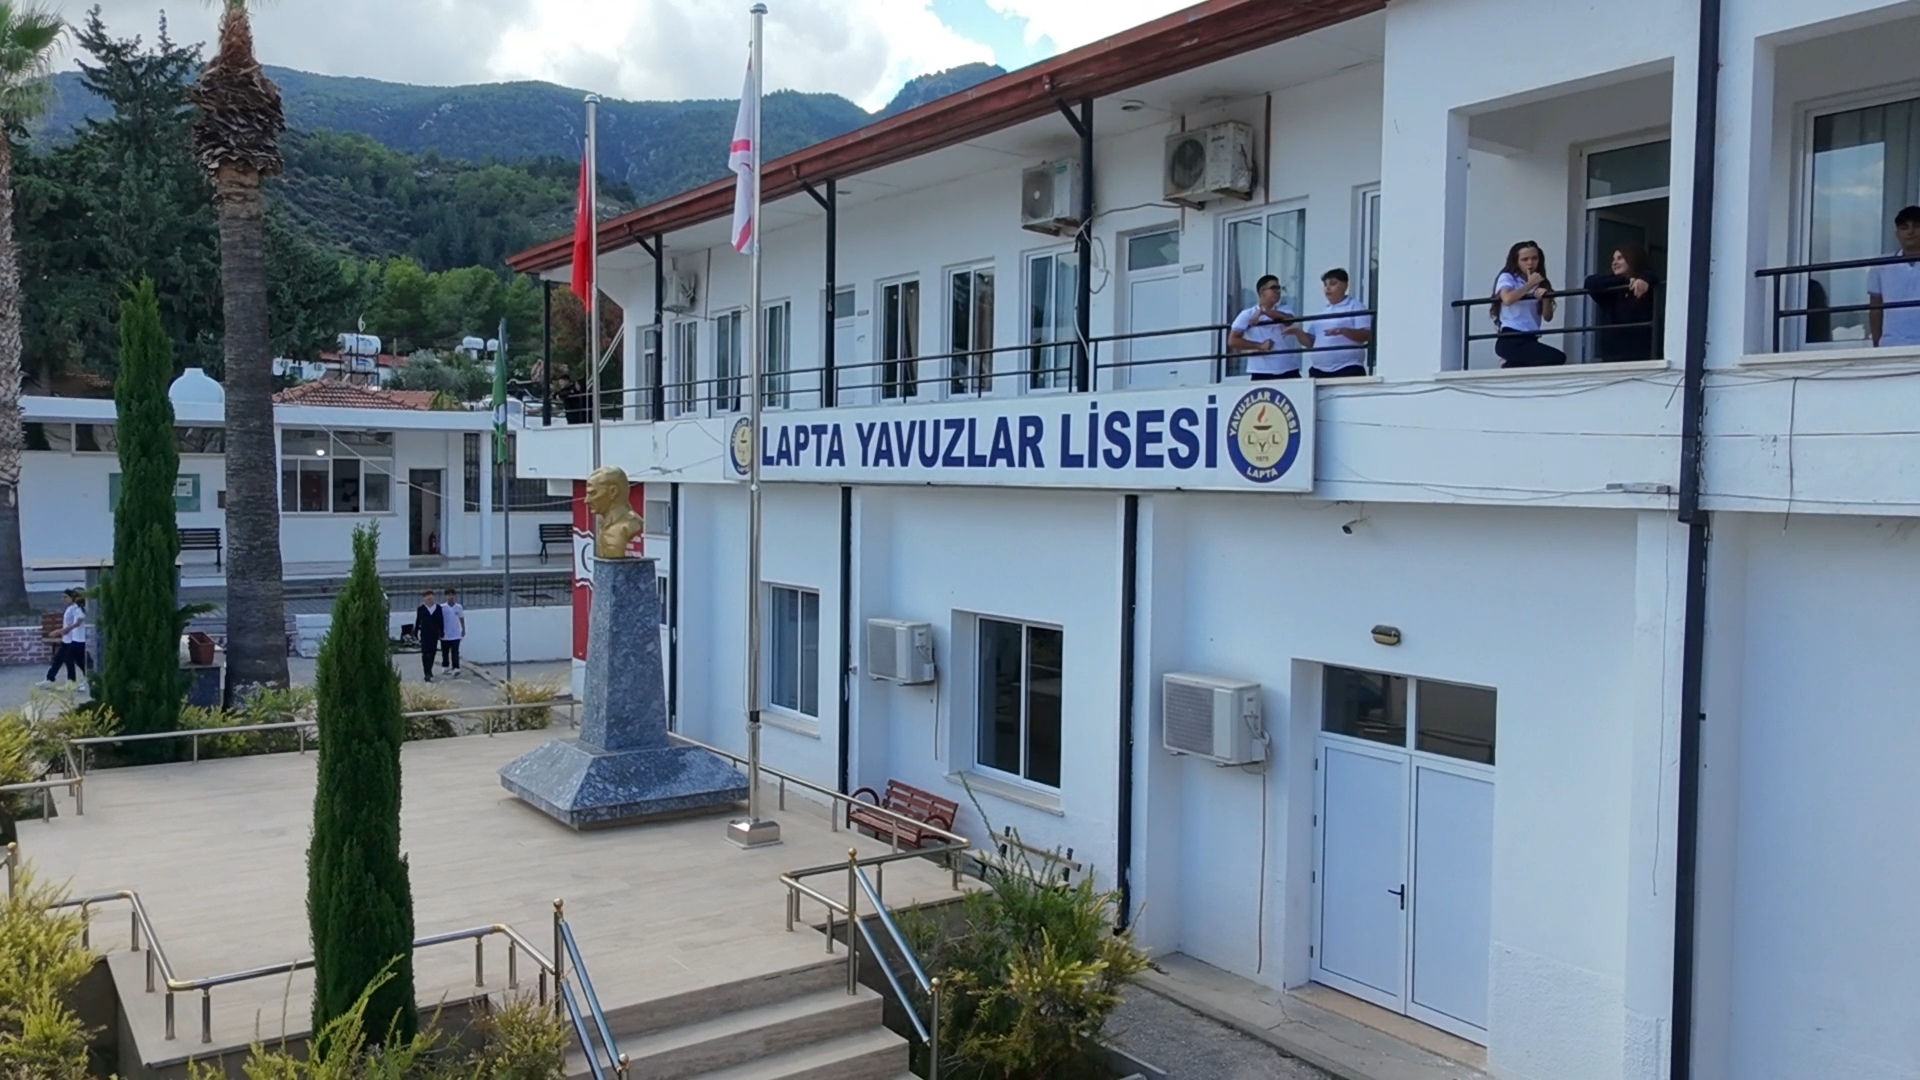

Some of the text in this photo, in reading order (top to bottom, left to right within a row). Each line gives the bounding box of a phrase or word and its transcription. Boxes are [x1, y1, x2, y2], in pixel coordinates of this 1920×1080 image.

[762, 423, 846, 467] LAPTA
[855, 415, 1045, 468] YAVUZLAR
[1060, 394, 1218, 469] LİSESİ
[1229, 391, 1271, 437] YAVUZLAR
[1246, 466, 1278, 479] LAPTA
